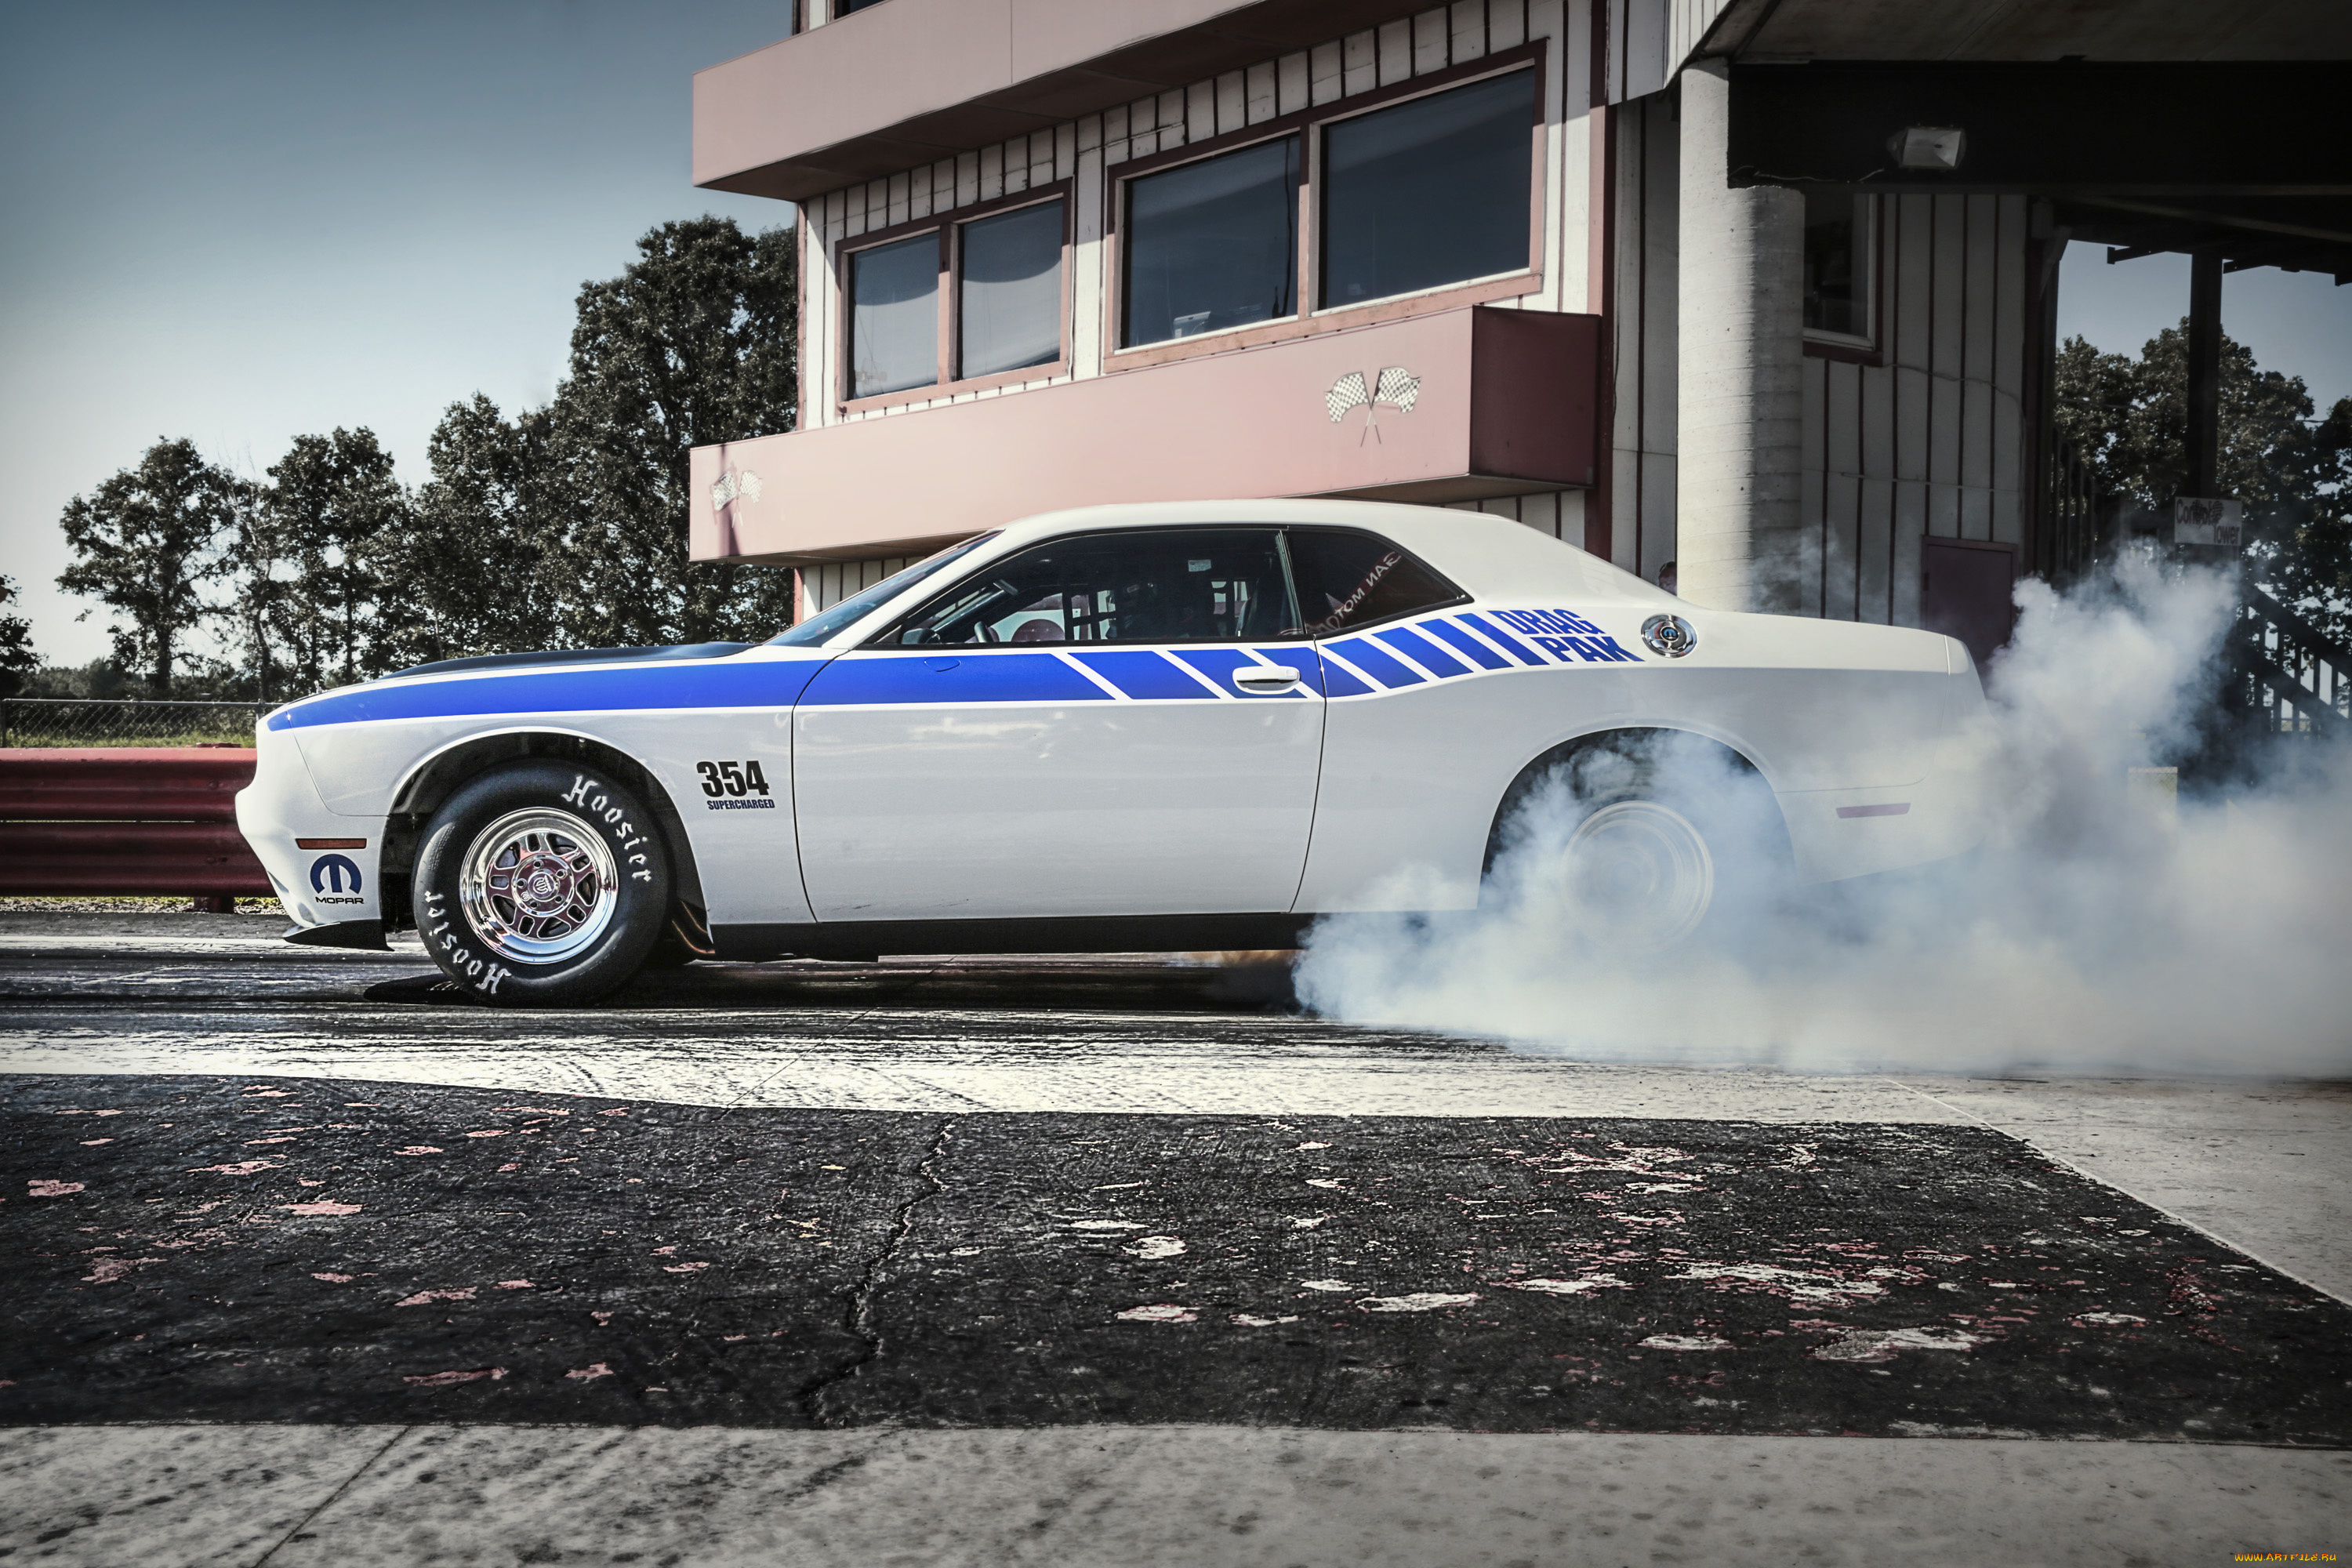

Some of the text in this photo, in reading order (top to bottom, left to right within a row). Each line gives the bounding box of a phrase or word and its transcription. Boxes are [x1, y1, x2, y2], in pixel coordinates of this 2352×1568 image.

[1486, 609, 1606, 635] DRAG
[1530, 637, 1646, 662] PAK
[696, 760, 770, 797] 354
[706, 799, 775, 810] SUPERCHARGED
[561, 775, 652, 882] Hoosier
[315, 896, 365, 905] MOPAR
[424, 891, 512, 994] Hoosier
